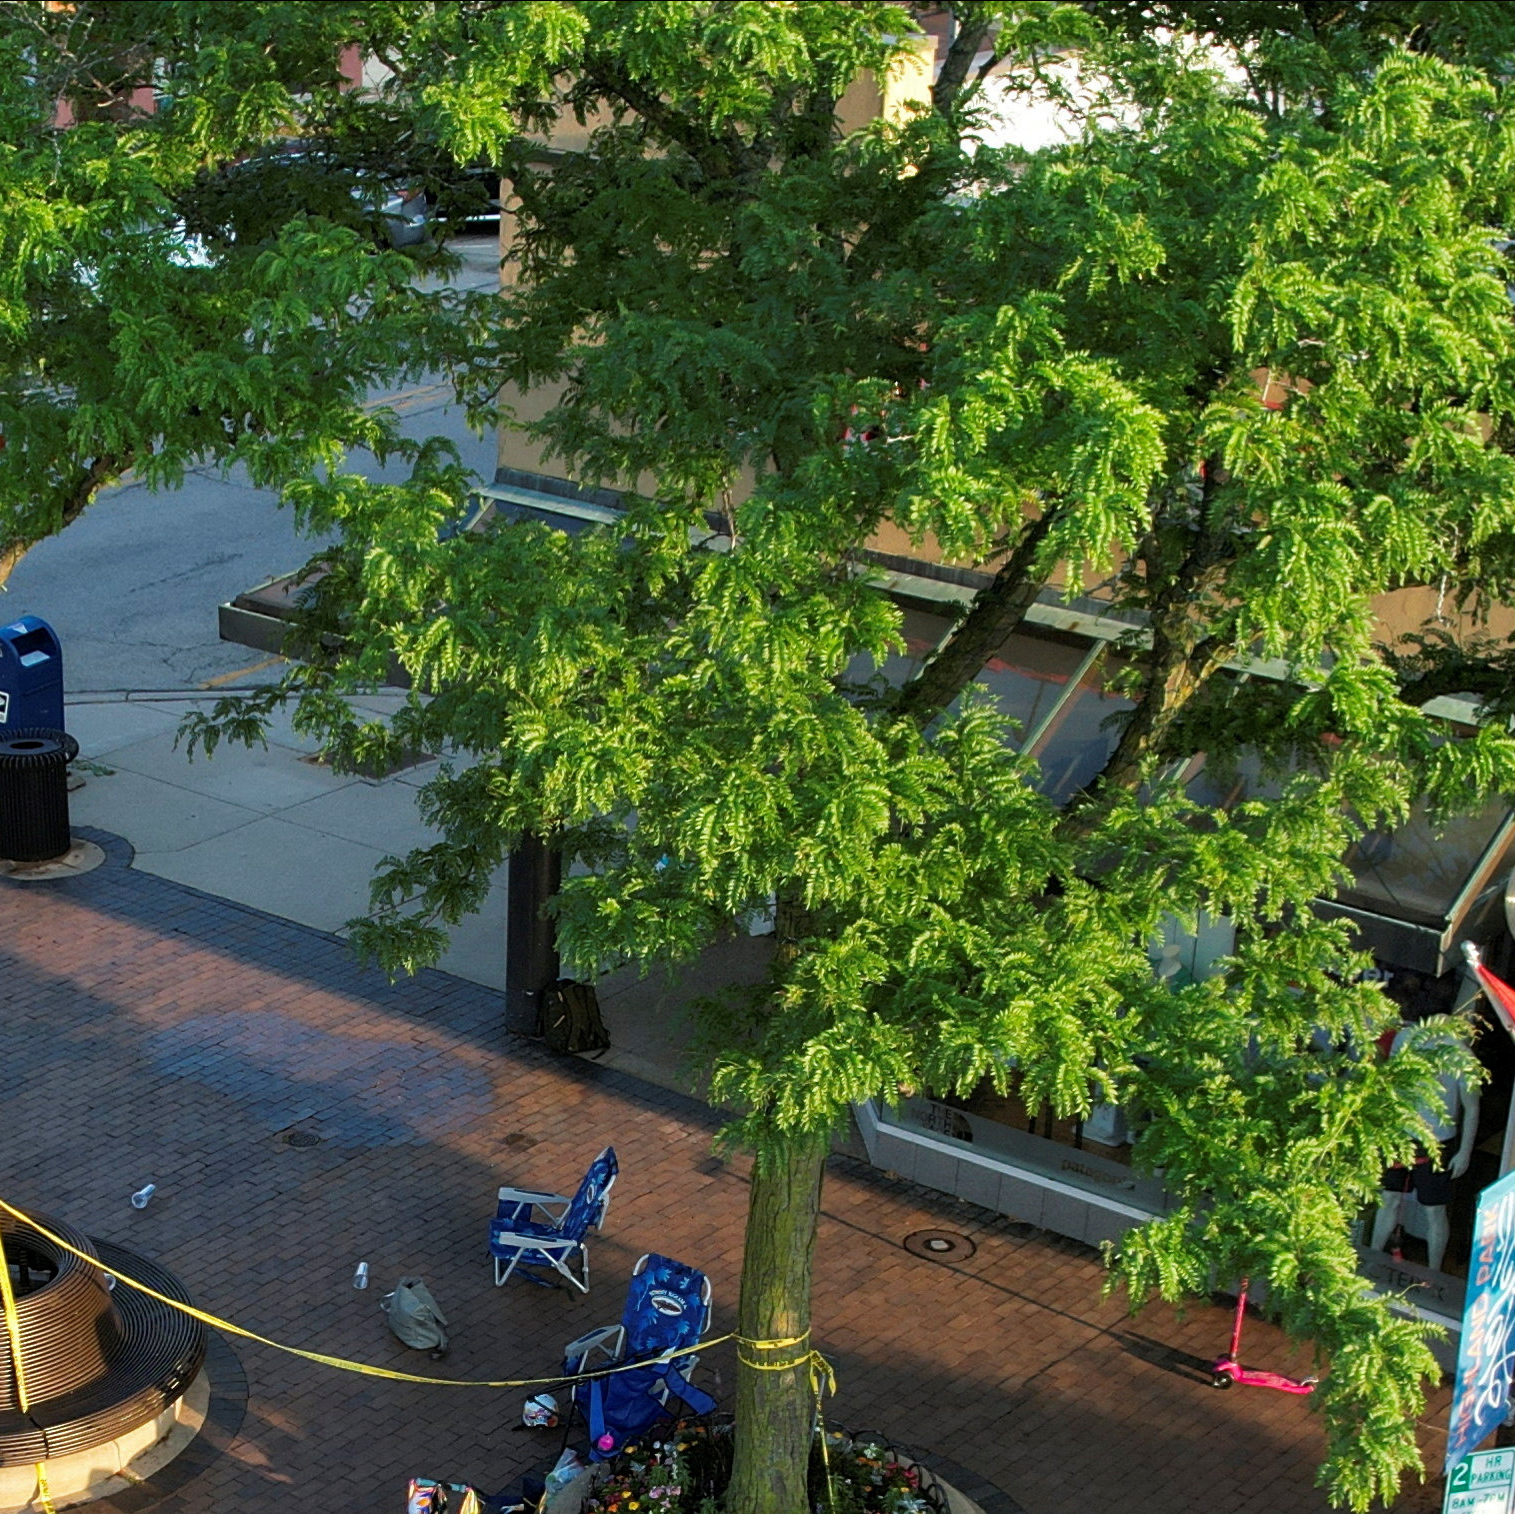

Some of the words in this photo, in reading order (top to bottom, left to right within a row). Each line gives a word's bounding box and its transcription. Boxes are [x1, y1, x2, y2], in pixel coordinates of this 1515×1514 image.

[1478, 1204, 1498, 1285] PARK
[1453, 1463, 1469, 1486] 2
[1486, 1456, 1502, 1467] HR
[1471, 1469, 1511, 1484] PARKING
